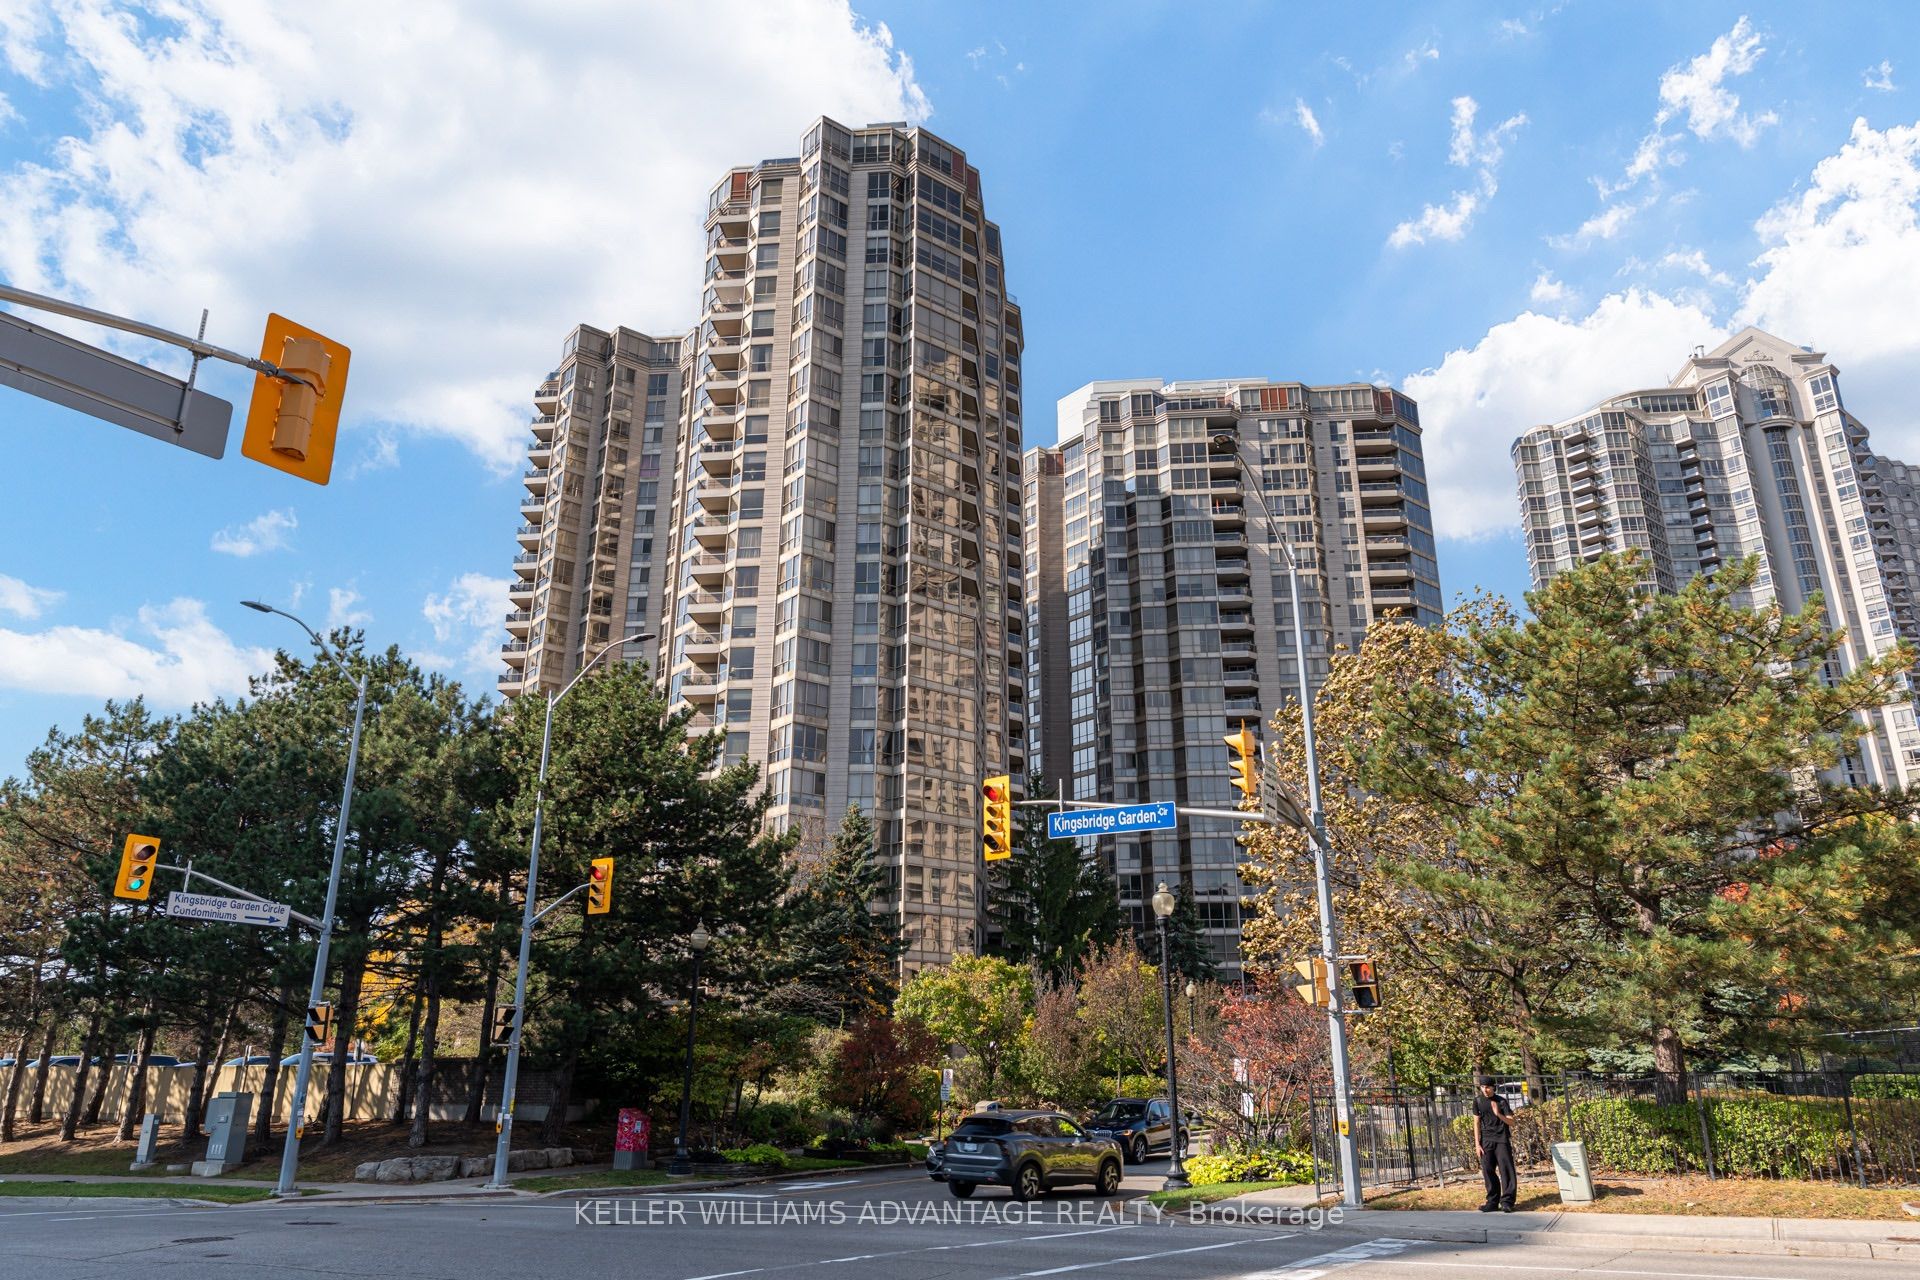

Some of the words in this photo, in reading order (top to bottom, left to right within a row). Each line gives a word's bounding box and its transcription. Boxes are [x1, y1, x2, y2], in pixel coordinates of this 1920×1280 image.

[1054, 813, 1115, 832] Kingsbridge
[1118, 810, 1156, 826] Garden
[173, 905, 237, 920] Condominiums
[175, 894, 227, 908] Kingsbridge
[230, 900, 260, 912] Garden
[262, 903, 285, 914] Circle
